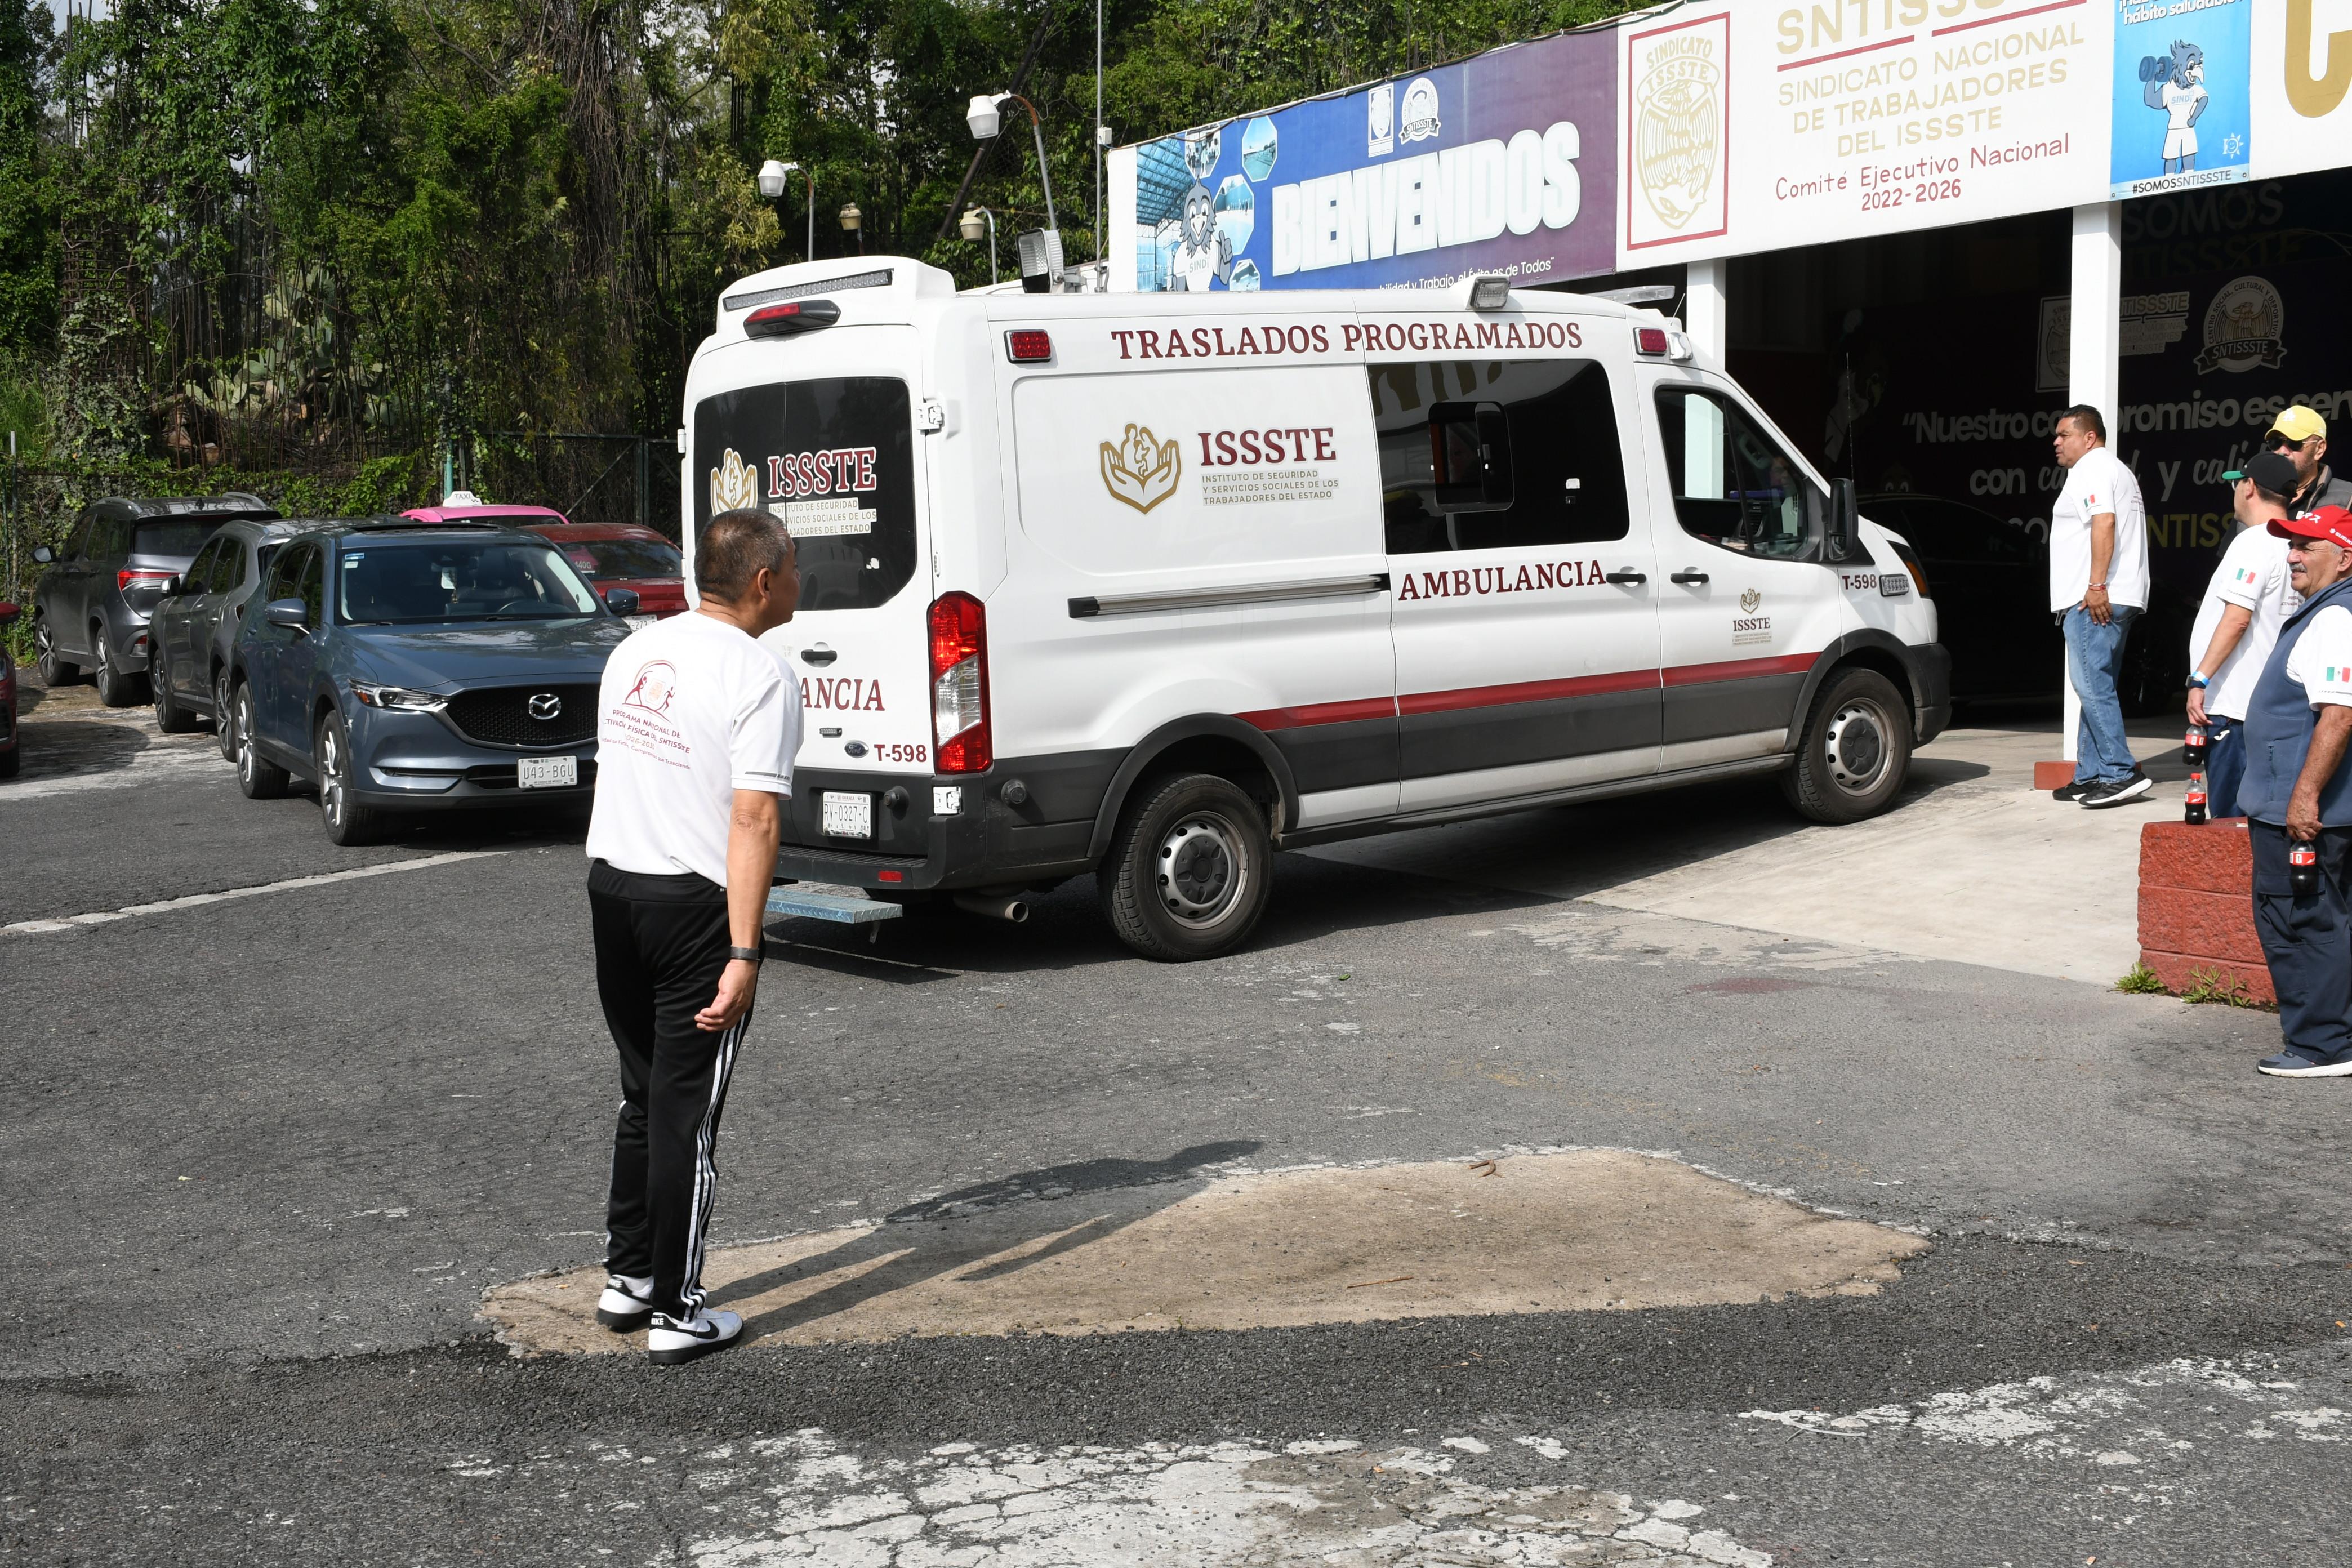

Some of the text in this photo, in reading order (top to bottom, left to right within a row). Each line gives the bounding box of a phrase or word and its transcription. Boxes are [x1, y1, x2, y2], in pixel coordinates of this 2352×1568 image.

[2123, 5, 2167, 25] hábito
[1647, 36, 1713, 69] SINDICATO
[1778, 22, 2084, 106] SINDICATO NACIONAL
[1646, 61, 1710, 93] ISSSTE
[1794, 58, 2067, 134] DE TRABAJADORES
[1406, 119, 1432, 133] SNTISSSTE
[1838, 106, 2002, 158] DEL ISSSTE
[1776, 132, 2069, 201] Comité Ejecutivo Nacional
[1272, 121, 1580, 276] BIENVENIDOS
[1861, 179, 1961, 211] 2022-2026
[1505, 264, 1518, 276] de
[2120, 293, 2188, 315] TISSSTE
[2234, 282, 2265, 293] CULTURAL
[2268, 295, 2279, 337] DEPORTIVO
[1111, 322, 1583, 359] TRASLADOS PROGRAMADOS
[2212, 341, 2269, 359] SNTISSSTE
[2243, 394, 2285, 425] es
[1198, 427, 1337, 466] ISSSTE
[768, 448, 876, 496] ISSSTE
[1202, 474, 1249, 483] INSTITUTO
[1267, 470, 1318, 479] SEGURIDAD
[1970, 468, 2026, 495] con
[2158, 461, 2181, 502] y
[1212, 484, 1259, 493] SERVICIOS
[1263, 482, 1305, 491] SOCIALES
[770, 504, 803, 513] INSTTUTO
[817, 500, 858, 510] SEGURIDAD
[1204, 494, 1276, 505] TRABAJADORES
[782, 511, 876, 524] RVICIOS SOCIALES DE LOS
[789, 526, 822, 537] AJADORES
[841, 524, 870, 533] ESTADO
[1398, 560, 1606, 601] AMBULANCIA
[1842, 574, 1877, 590] T-598
[1733, 617, 1770, 631] ISSSTE
[801, 677, 885, 711] ANCIA
[627, 725, 649, 737] FÍSICA
[847, 744, 862, 754] Ford
[874, 744, 927, 763] T-598
[524, 764, 573, 779] U43-BGU
[825, 803, 868, 823] RV-0327-C
